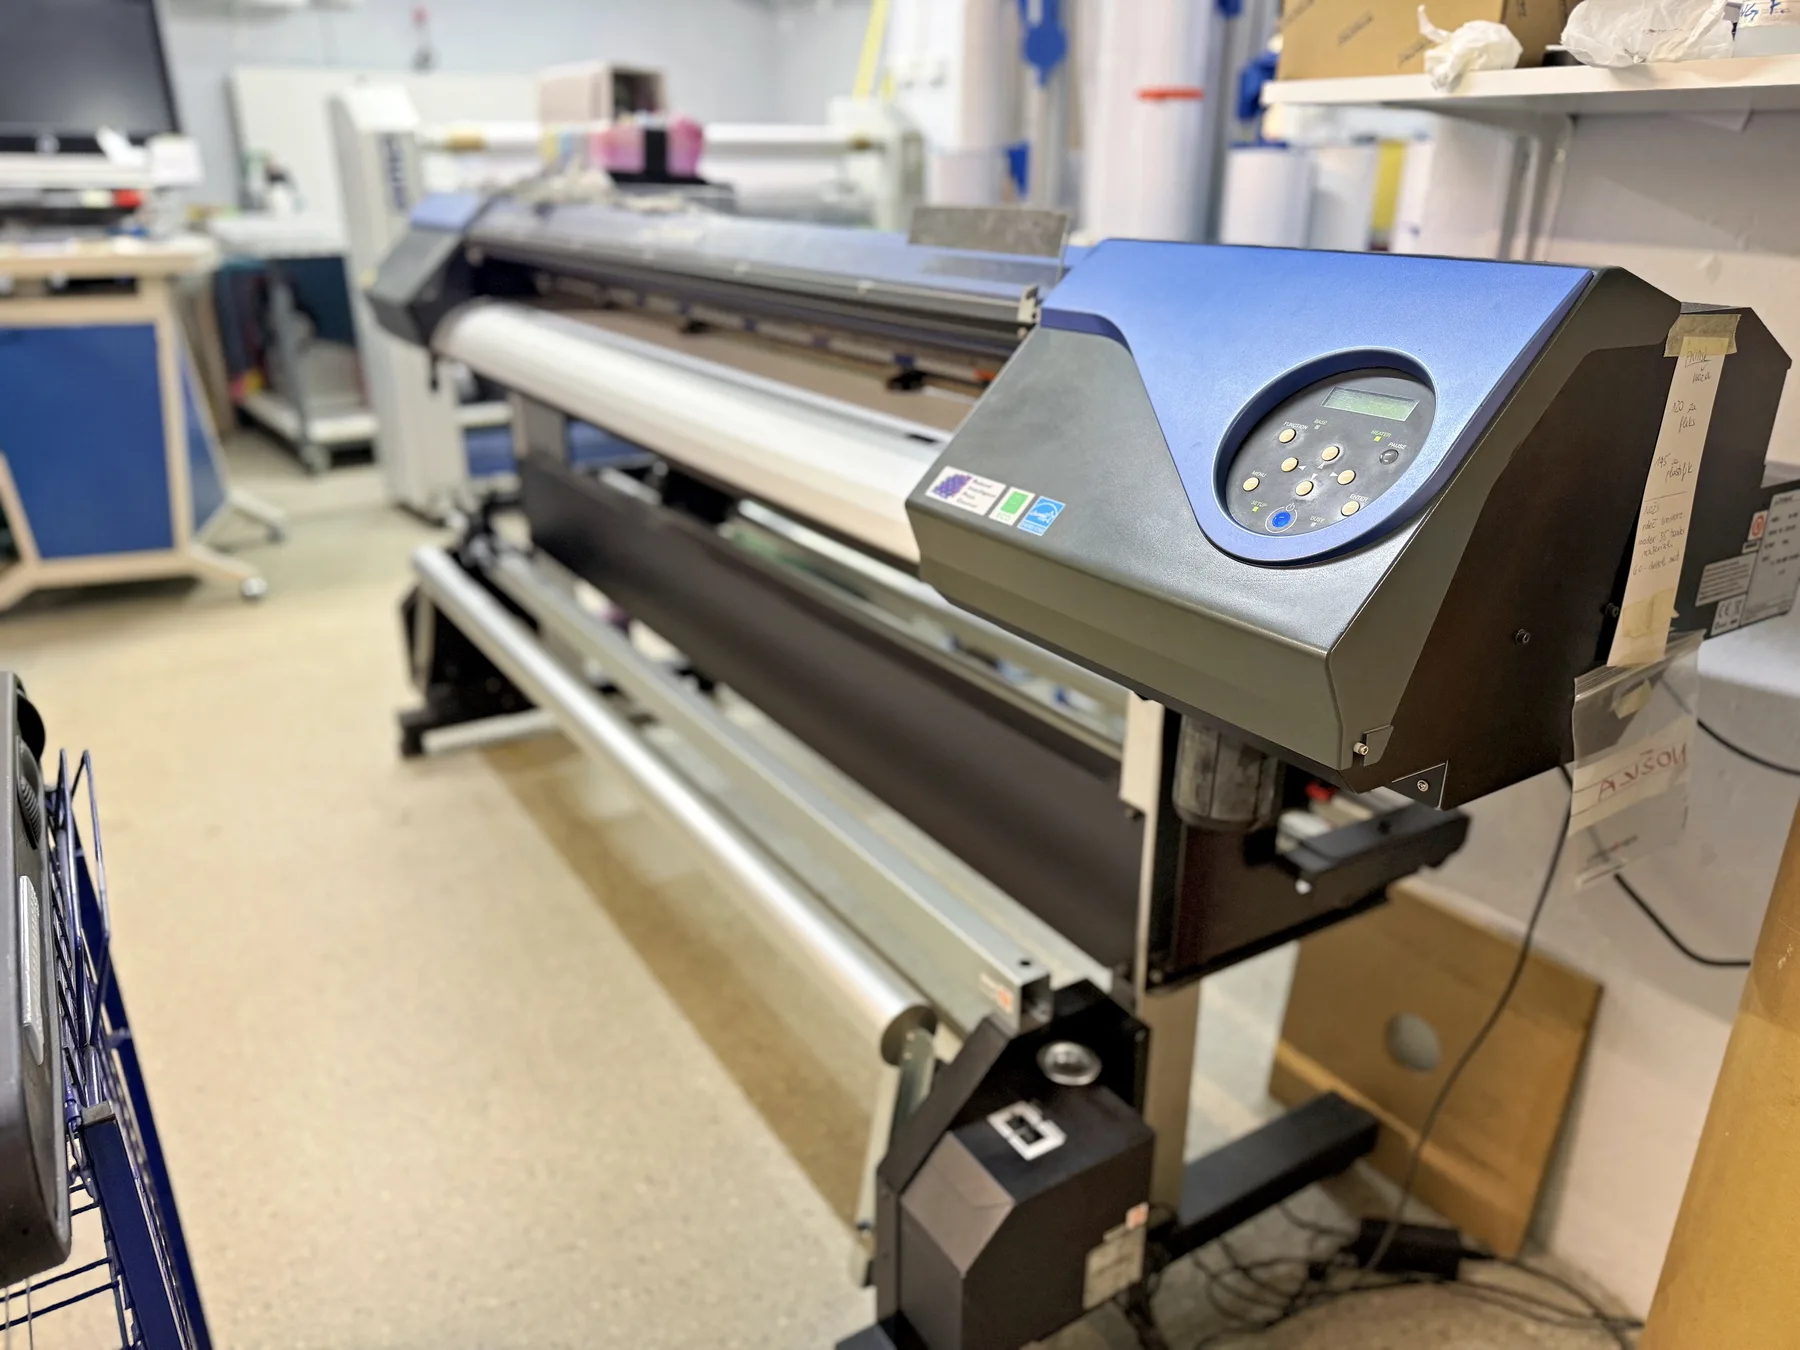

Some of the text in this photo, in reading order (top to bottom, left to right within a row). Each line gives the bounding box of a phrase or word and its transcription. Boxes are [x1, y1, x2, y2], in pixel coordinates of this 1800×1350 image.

[1283, 421, 1308, 430] FUNCTION
[1388, 442, 1407, 450] PAUSE
[1252, 470, 1267, 478] MENU
[1350, 493, 1369, 502] ENTER
[1310, 515, 1325, 523] BUSY
